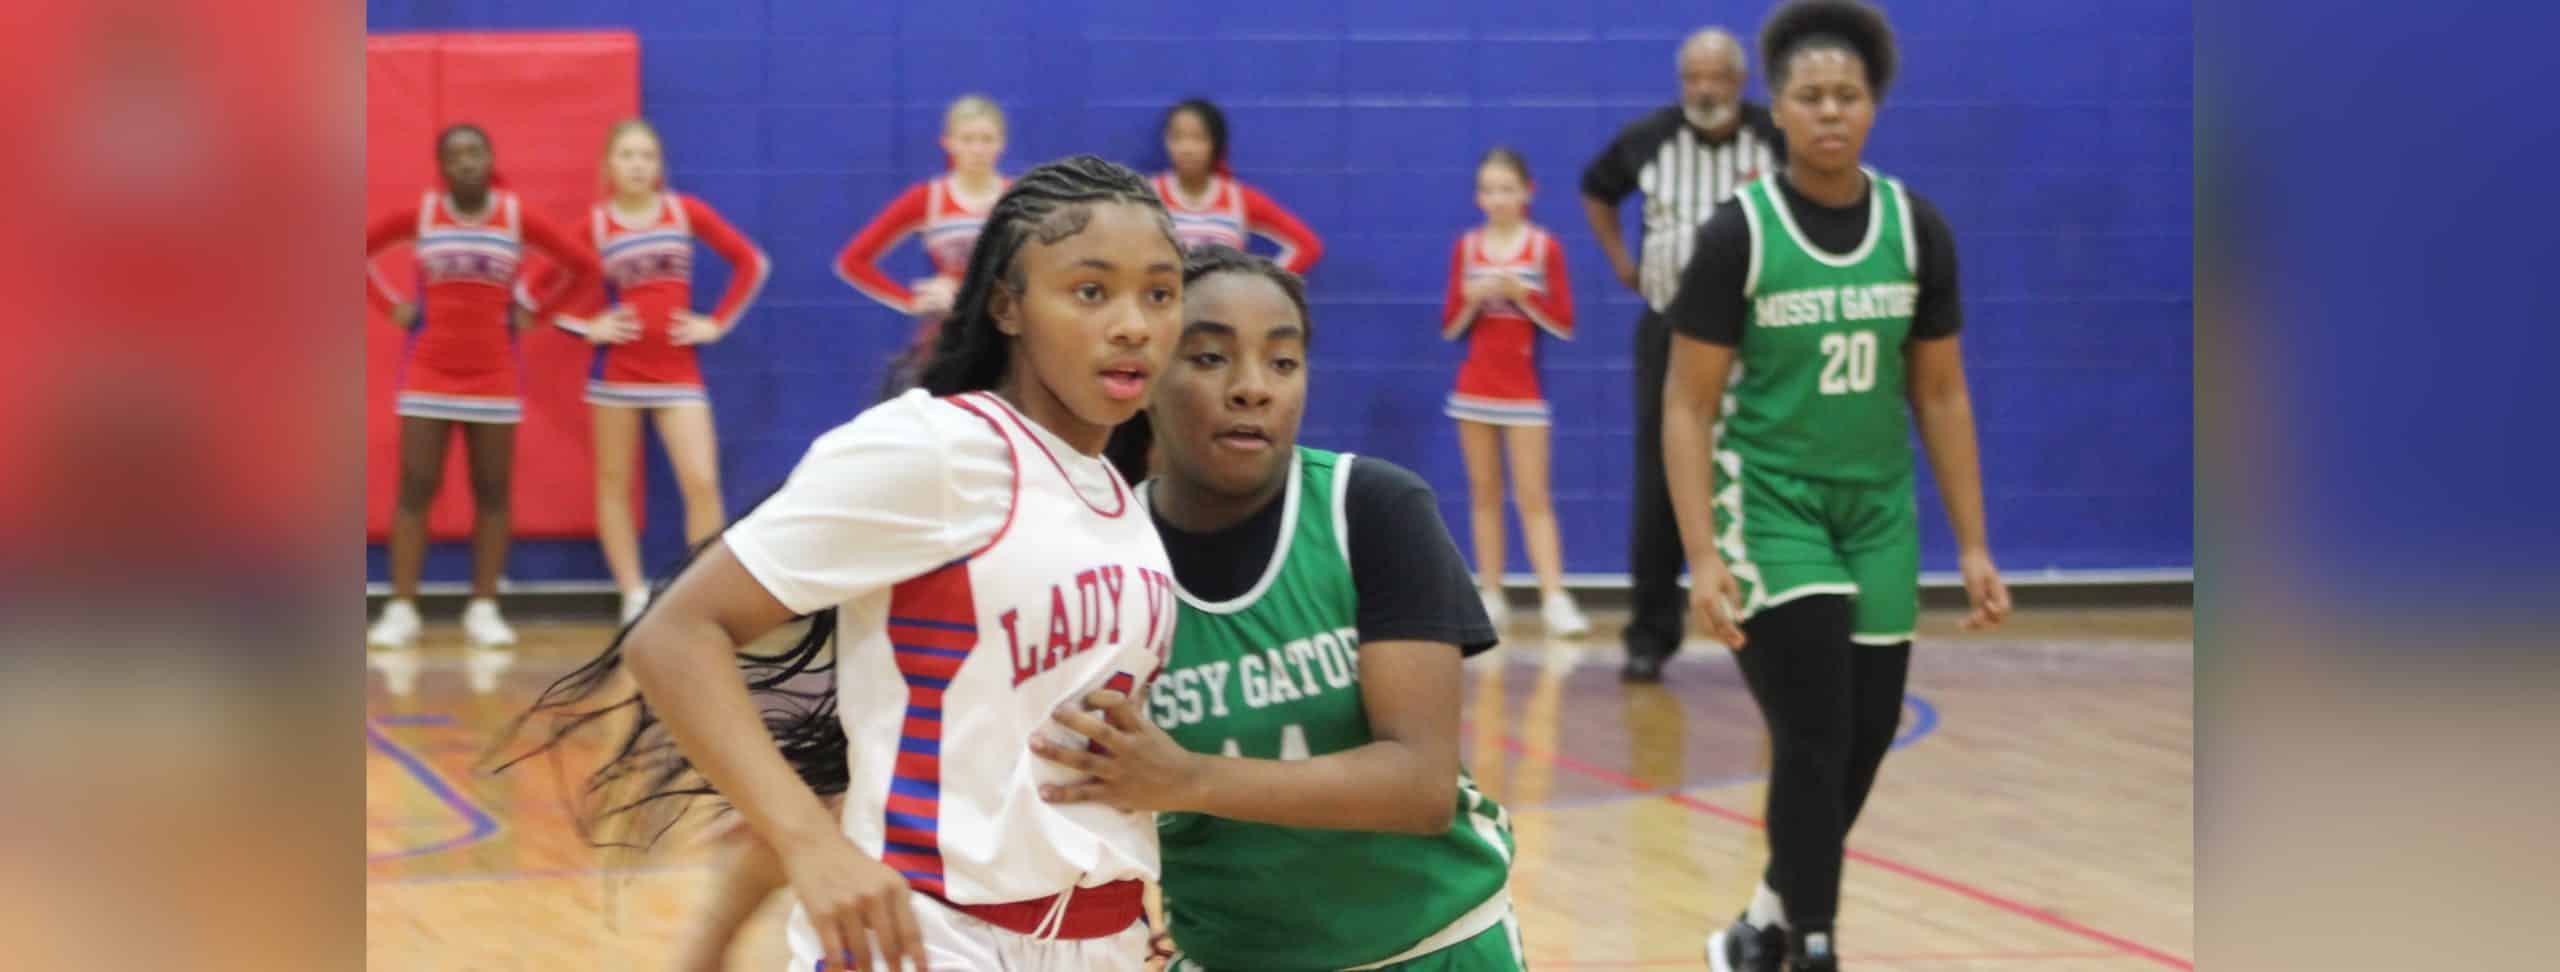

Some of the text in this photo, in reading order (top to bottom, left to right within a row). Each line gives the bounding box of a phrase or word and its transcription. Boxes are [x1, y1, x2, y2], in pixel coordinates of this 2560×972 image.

[1755, 287, 1836, 327] MISSY
[1819, 330, 1877, 395] 20
[998, 564, 1124, 688] LADY
[1143, 660, 1230, 730] SSY
